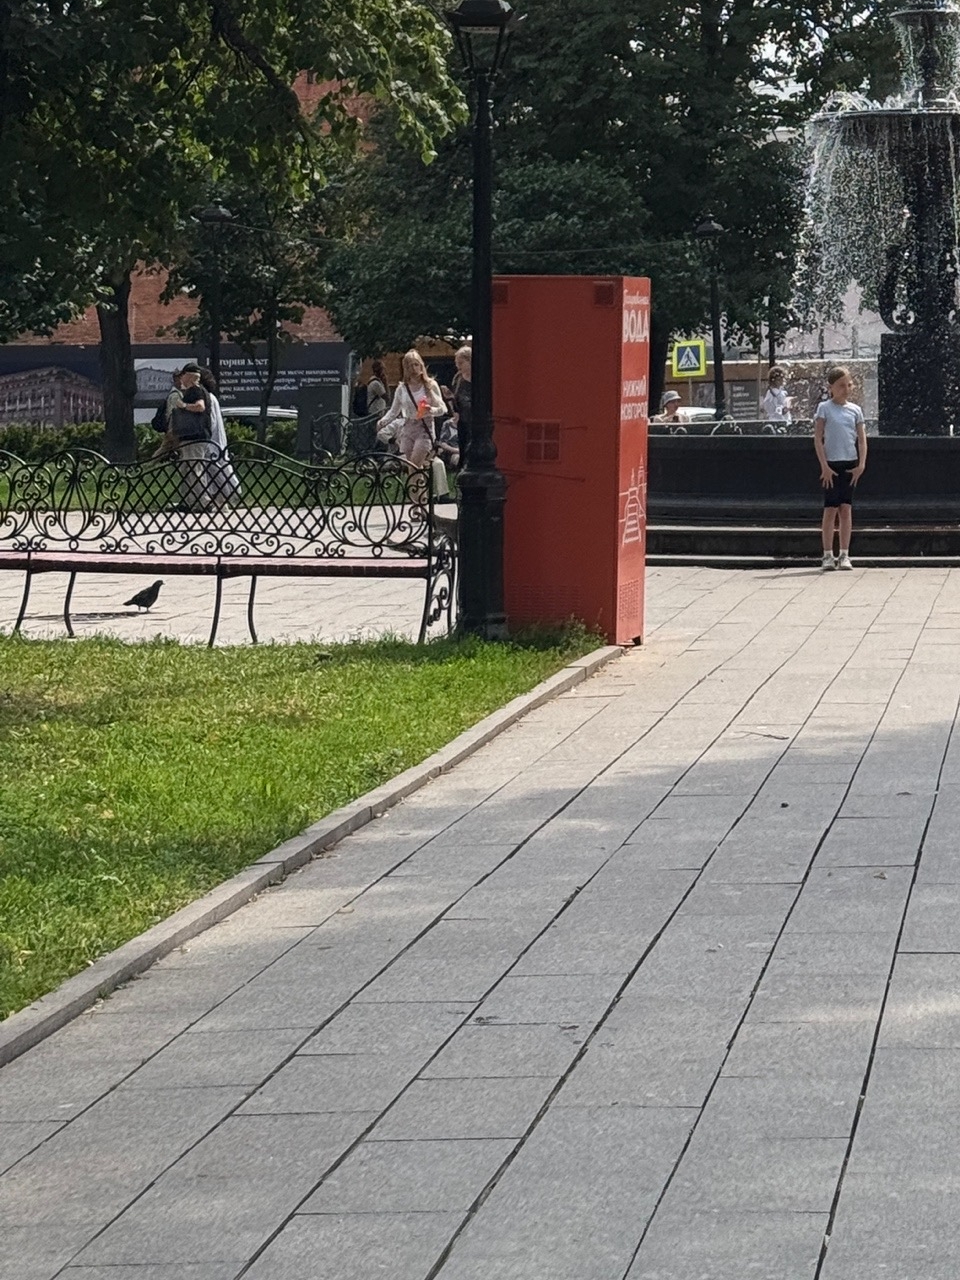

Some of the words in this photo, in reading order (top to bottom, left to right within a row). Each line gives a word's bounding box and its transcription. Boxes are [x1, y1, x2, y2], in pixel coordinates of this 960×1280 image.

[623, 309, 649, 343] ВОДА
[622, 375, 646, 397] НИЖНИЙ
[620, 401, 648, 420] НОВГОРОД
